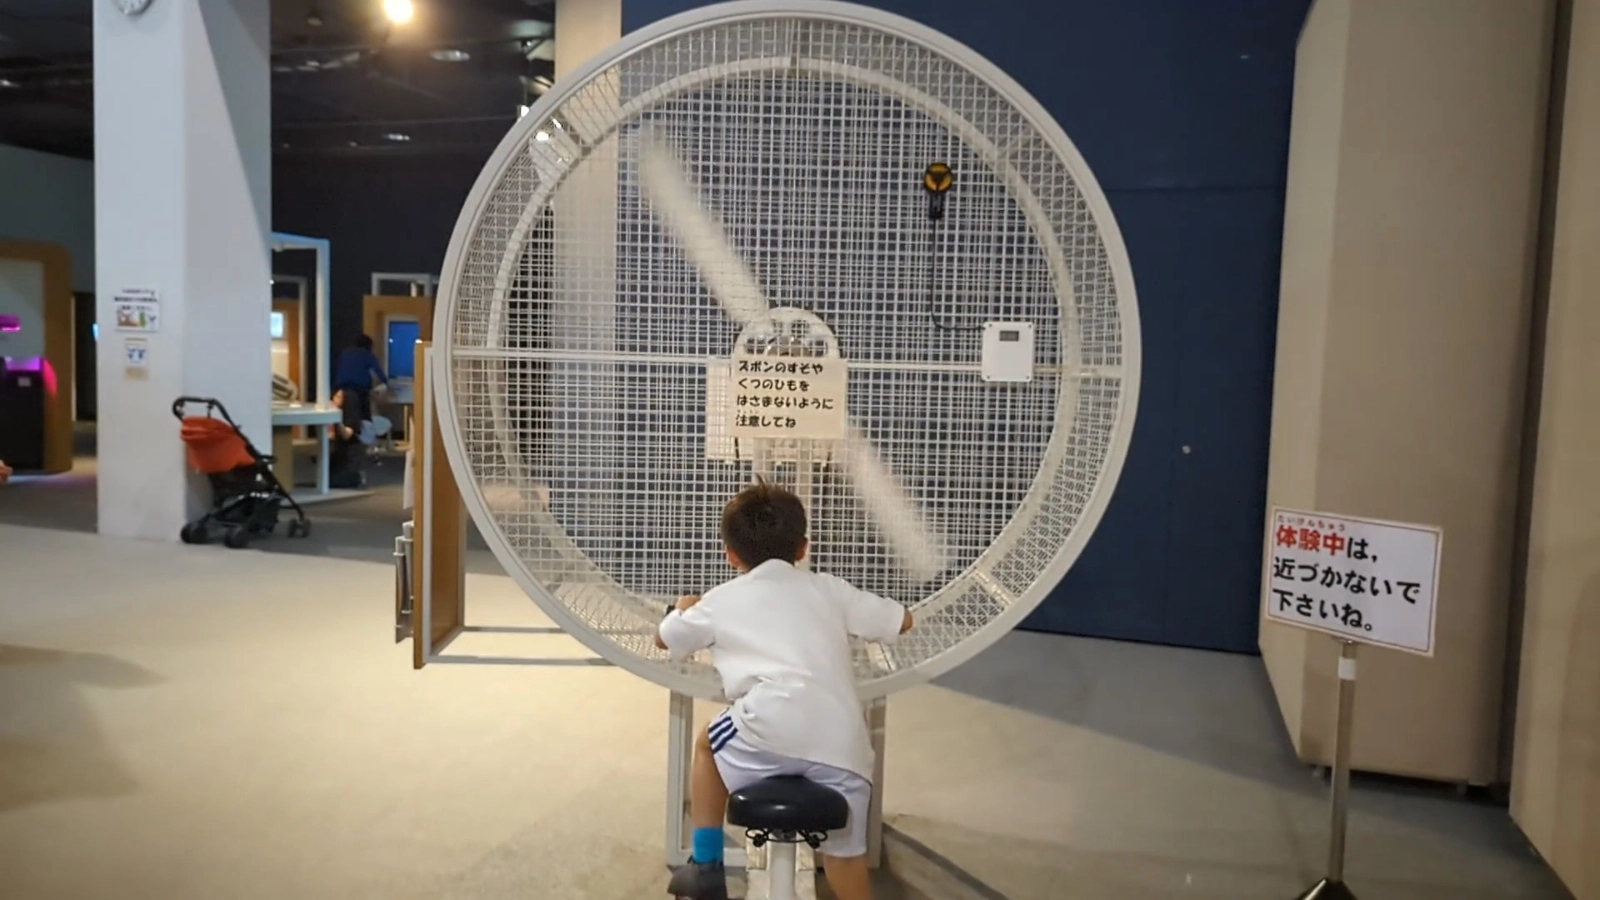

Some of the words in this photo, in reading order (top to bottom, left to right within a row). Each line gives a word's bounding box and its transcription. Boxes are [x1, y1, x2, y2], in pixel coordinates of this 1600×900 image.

[738, 378, 810, 391] くつのひもを
[736, 395, 834, 410] はさまないように
[735, 414, 796, 427] 注意してね
[1273, 556, 1421, 604] 近づかないで
[1272, 588, 1373, 631] 下さいね。
